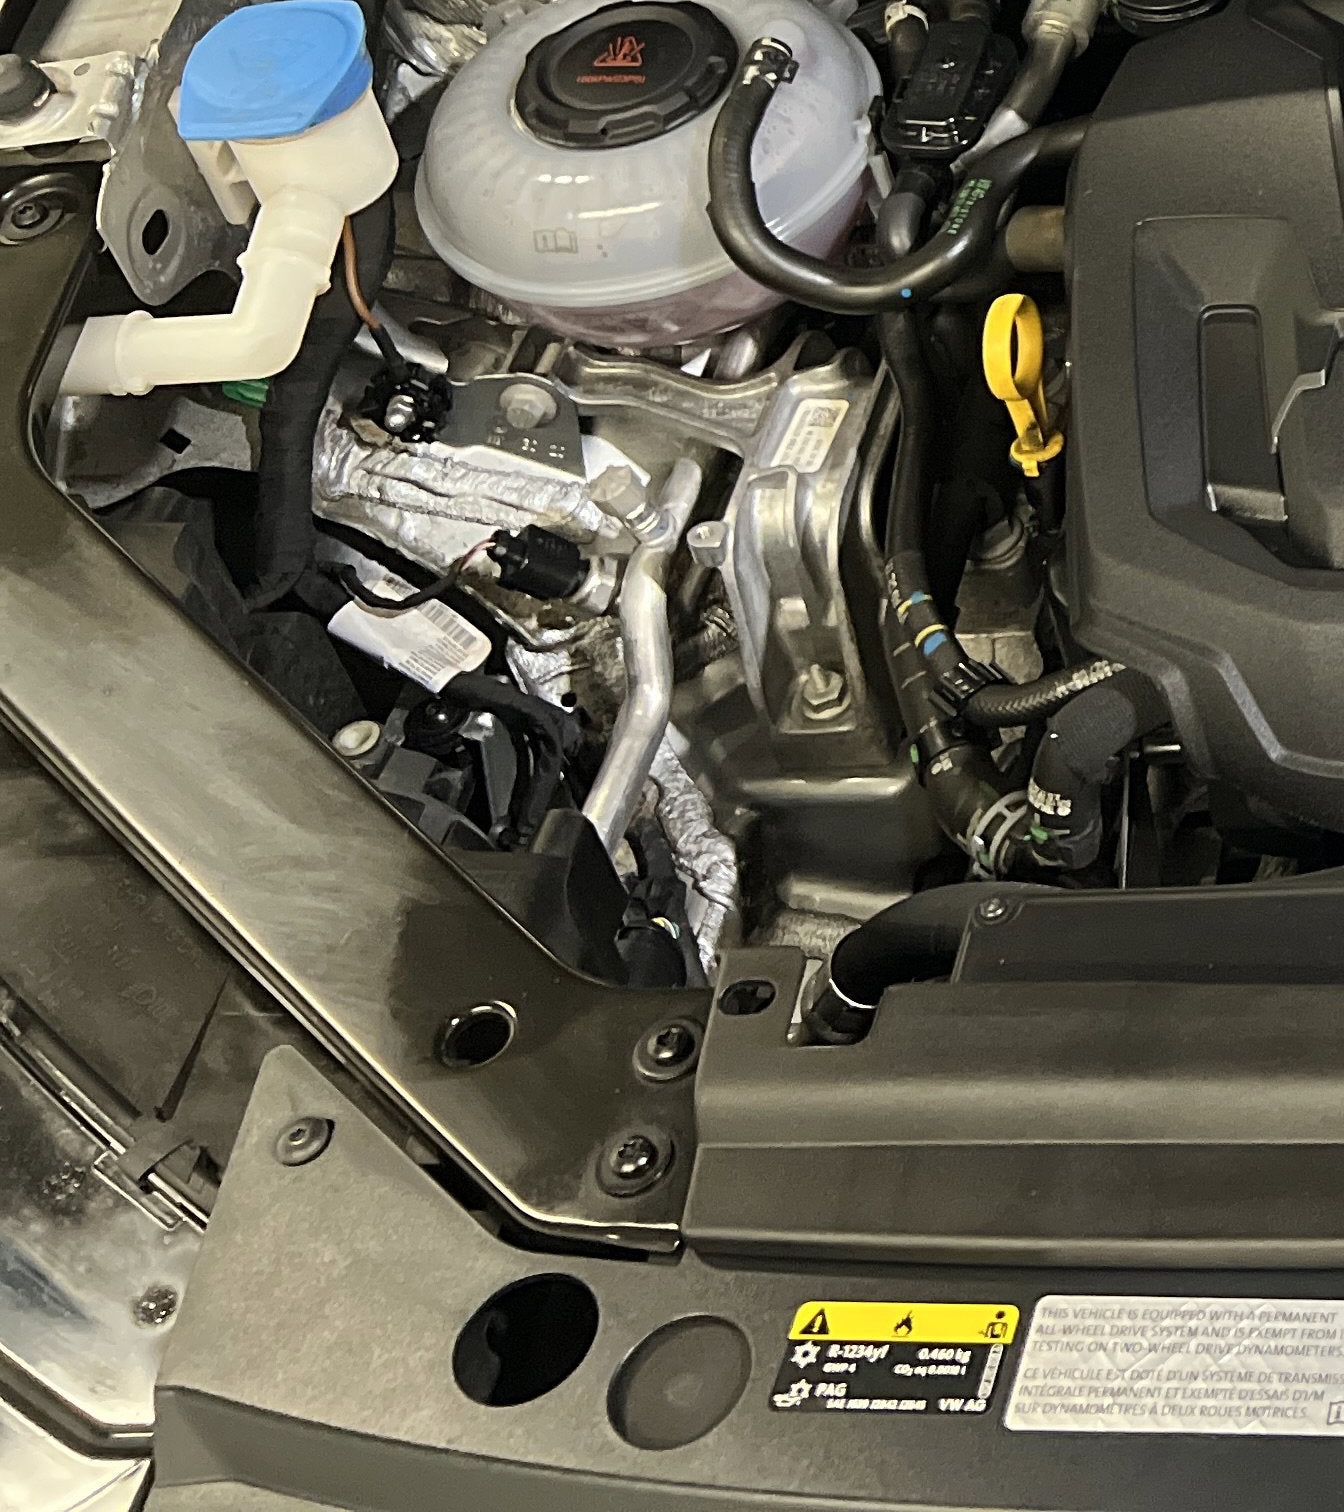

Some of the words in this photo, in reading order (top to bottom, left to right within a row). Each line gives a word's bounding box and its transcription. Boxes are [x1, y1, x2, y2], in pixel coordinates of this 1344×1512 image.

[1041, 1306, 1070, 1320] THIS
[1072, 1308, 1126, 1321] VEHICLE
[1127, 1309, 1139, 1320] IS
[1141, 1309, 1206, 1322] EQUIPPED
[1209, 1310, 1245, 1322] WITH
[1246, 1310, 1257, 1322] A
[1259, 1311, 1339, 1324] PERMANENT
[1108, 1324, 1149, 1337] DRIVE
[1150, 1325, 1199, 1338] SYSTEM
[1200, 1326, 1232, 1338] AND
[1233, 1327, 1245, 1339] IS
[1248, 1327, 1298, 1340] EXEMPT
[1300, 1328, 1338, 1340] FROM
[1032, 1340, 1086, 1353] TESTING
[1086, 1341, 1108, 1353] ON
[1112, 1341, 1192, 1355] TWO-WHEEL
[1194, 1342, 1233, 1355] DRIVE
[1022, 1367, 1040, 1380] CE
[1105, 1368, 1128, 1381] EST
[1165, 1369, 1201, 1382] D'UN
[1257, 1371, 1275, 1384] DE
[813, 1381, 848, 1398] PAG
[1087, 1386, 1162, 1399] PERMANENT
[1164, 1387, 1181, 1399] ET
[937, 1397, 965, 1412] VW
[963, 1398, 988, 1413] AG
[1014, 1401, 1041, 1415] SUR
[1160, 1404, 1198, 1418] DEUX
[1199, 1404, 1243, 1418] ROUES
[1244, 1405, 1309, 1419] MOTRICES
